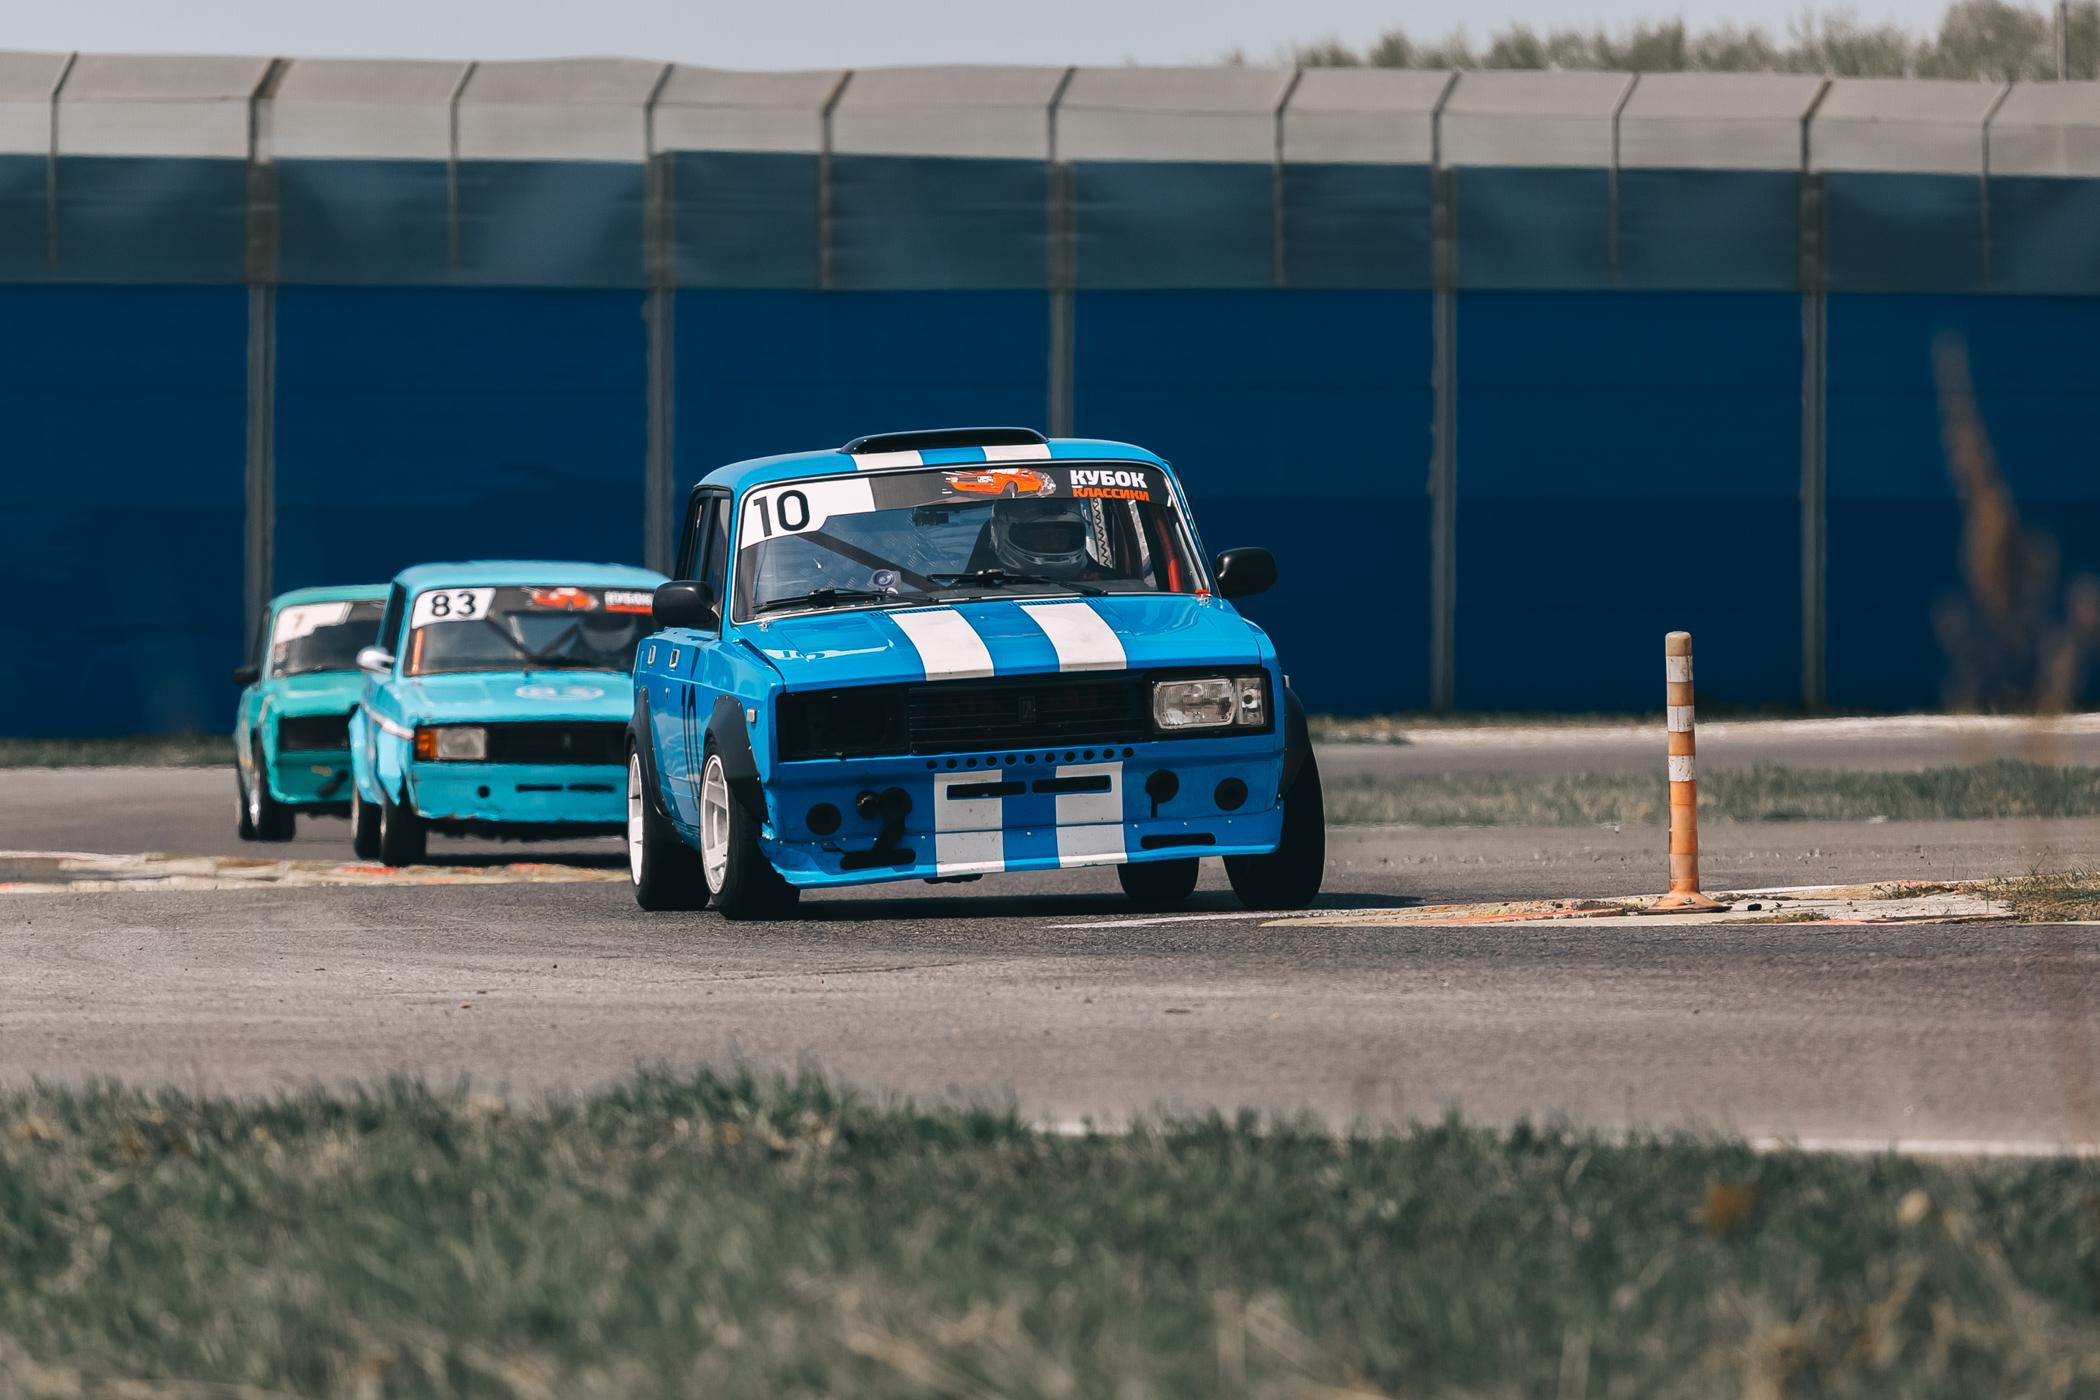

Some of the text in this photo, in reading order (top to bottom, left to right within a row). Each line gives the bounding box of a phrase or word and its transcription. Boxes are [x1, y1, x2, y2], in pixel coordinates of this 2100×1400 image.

[1070, 470, 1148, 489] КУБОК
[1072, 488, 1150, 501] КЛАССИКИ
[753, 490, 811, 537] 10
[431, 590, 477, 617] 83
